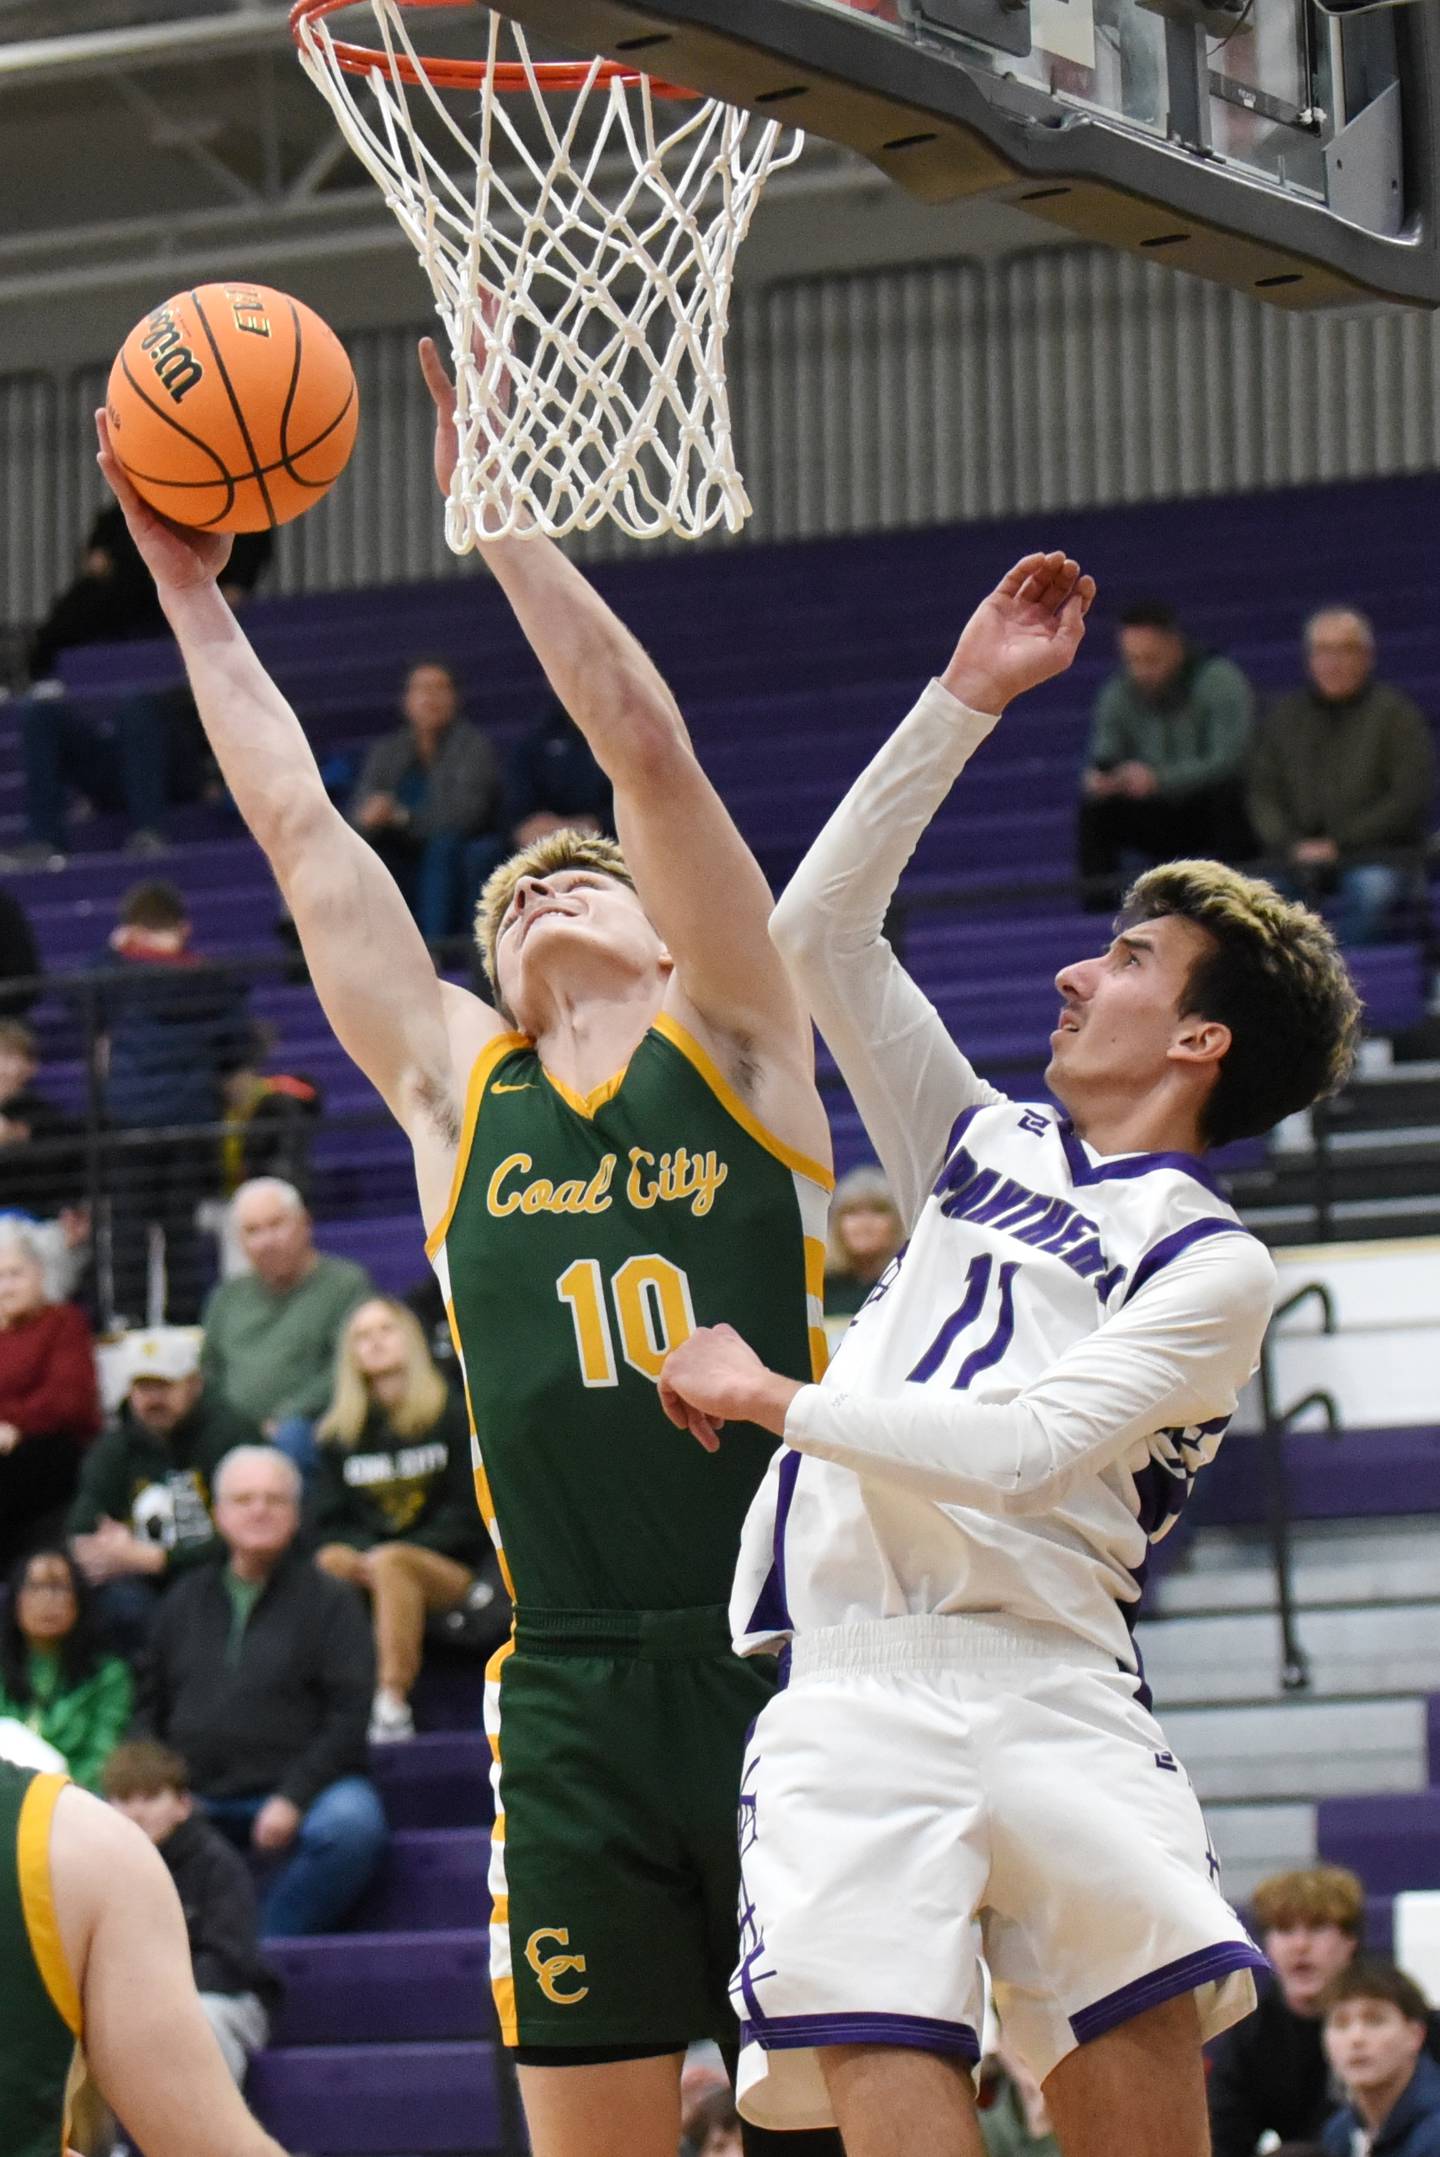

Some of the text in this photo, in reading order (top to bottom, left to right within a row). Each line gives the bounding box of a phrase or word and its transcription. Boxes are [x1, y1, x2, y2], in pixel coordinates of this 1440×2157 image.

[140, 302, 204, 405] Wils
[487, 1147, 728, 1217] Coal City
[556, 1254, 697, 1388] 10
[905, 1252, 1023, 1390] 11
[524, 1928, 589, 2005] CC
